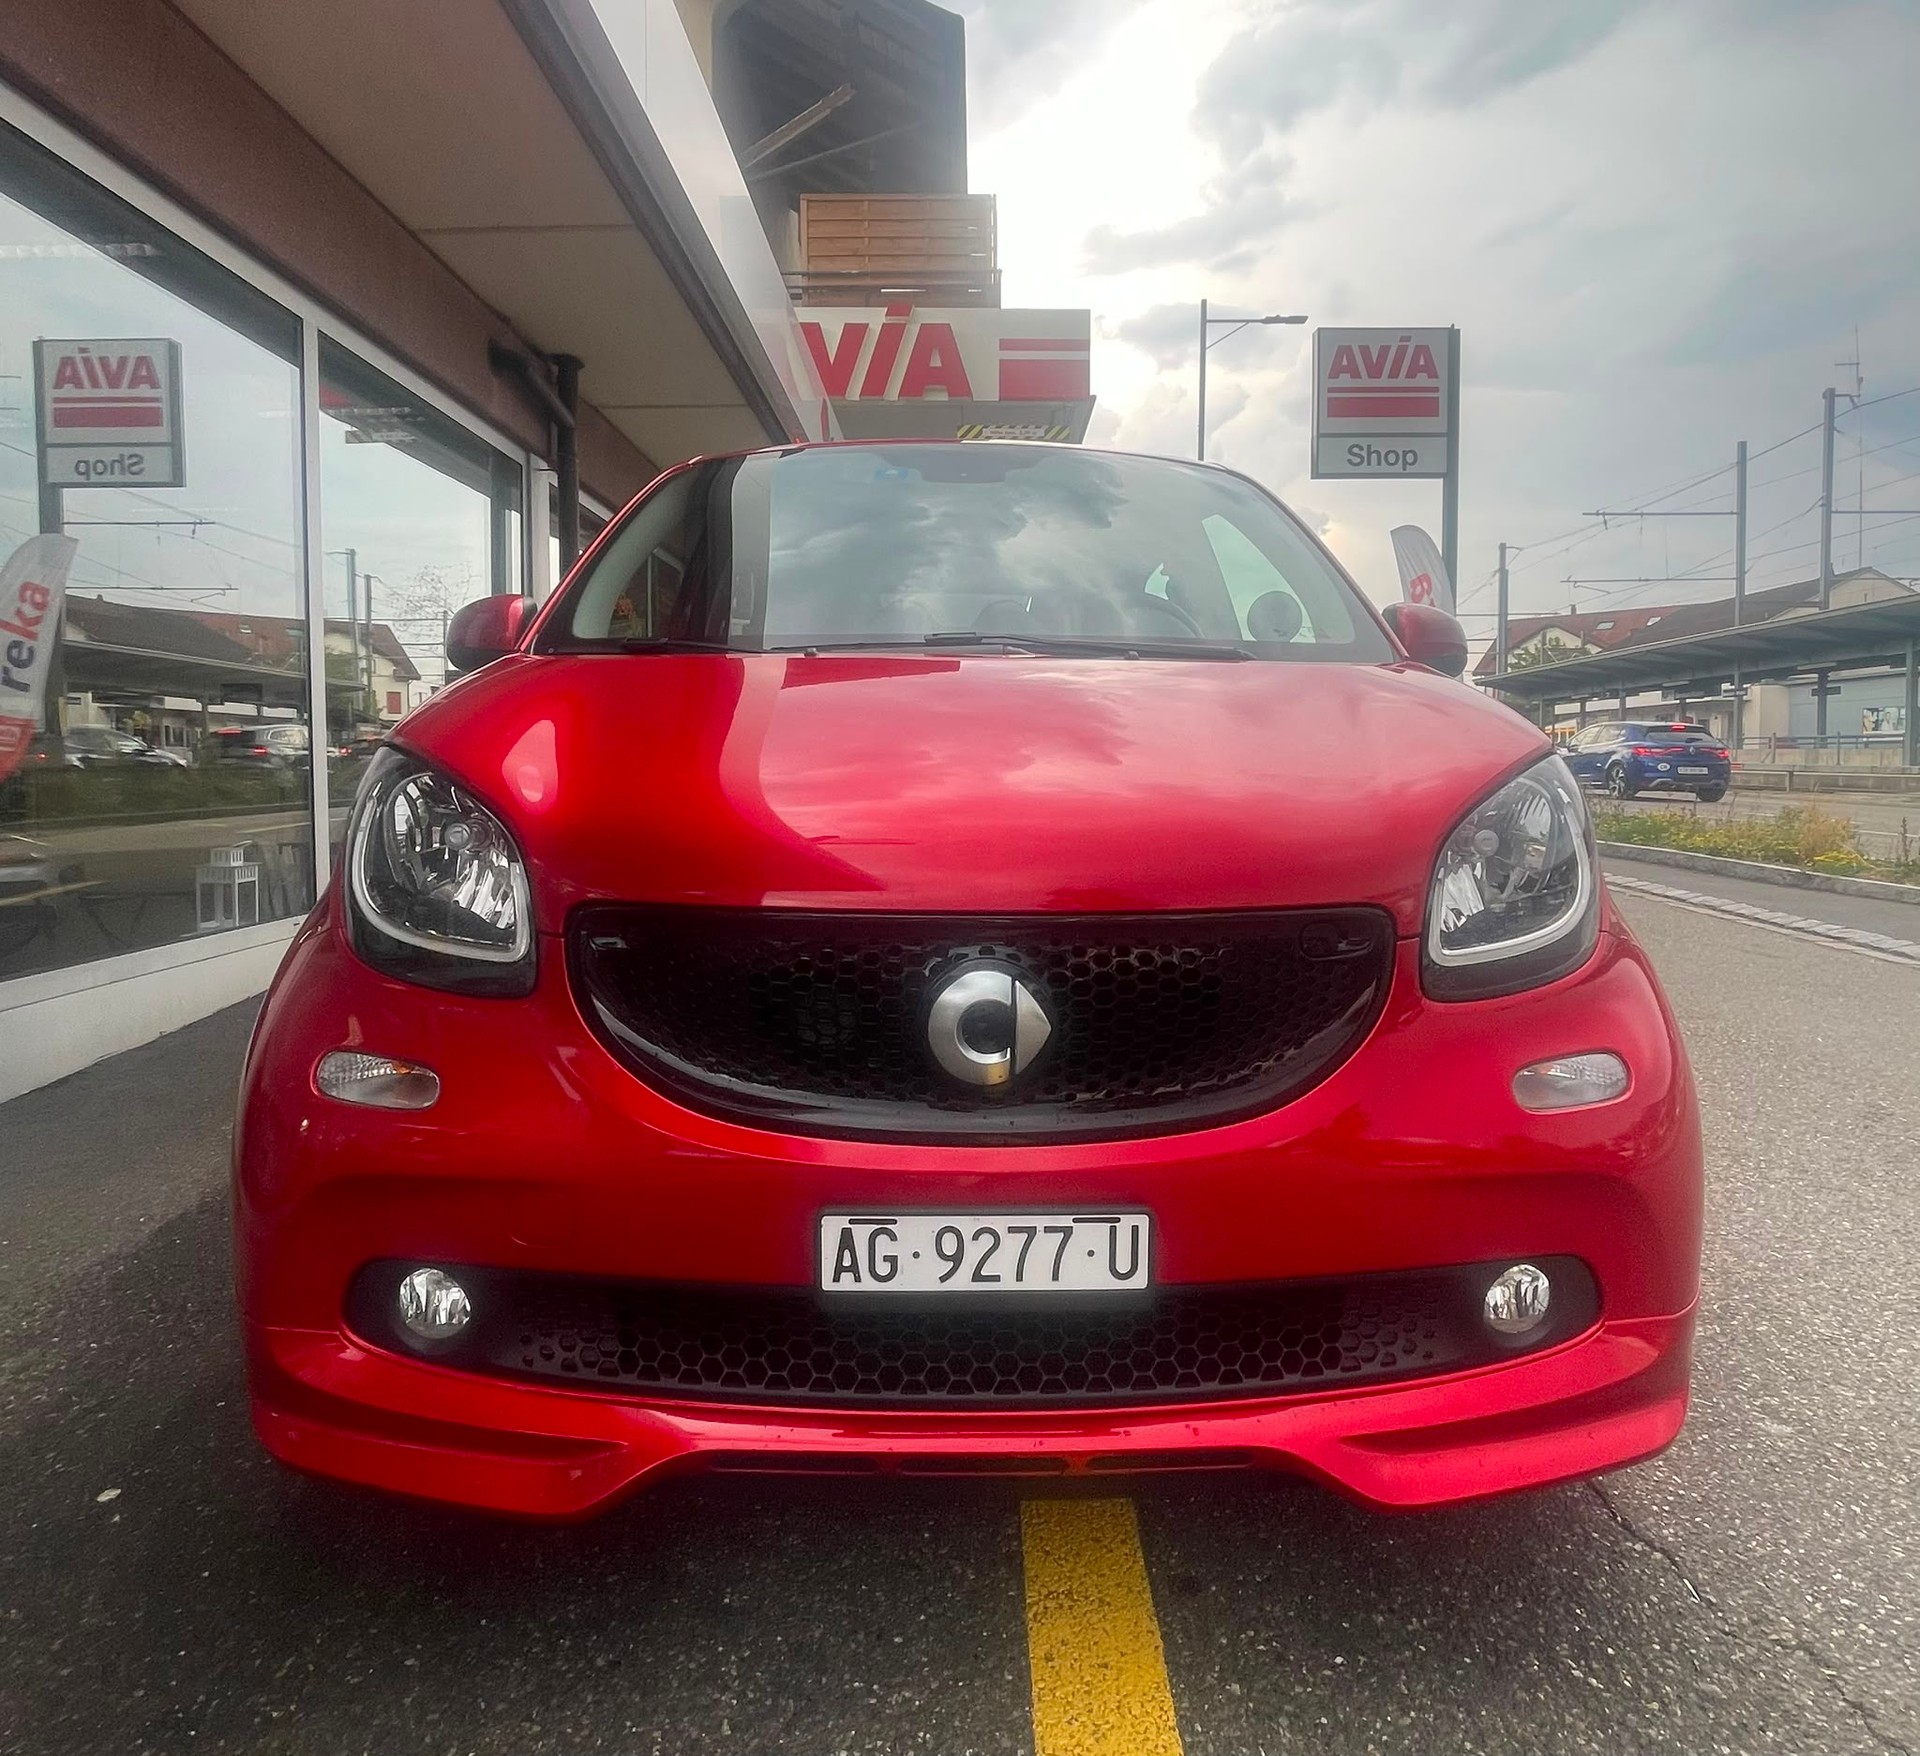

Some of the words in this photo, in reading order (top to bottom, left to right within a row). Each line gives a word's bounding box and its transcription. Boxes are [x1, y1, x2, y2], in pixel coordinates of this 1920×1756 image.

[798, 303, 974, 398] VIA
[1328, 335, 1439, 380] AVIA
[1346, 443, 1418, 471] Shop
[0, 581, 50, 693] reka
